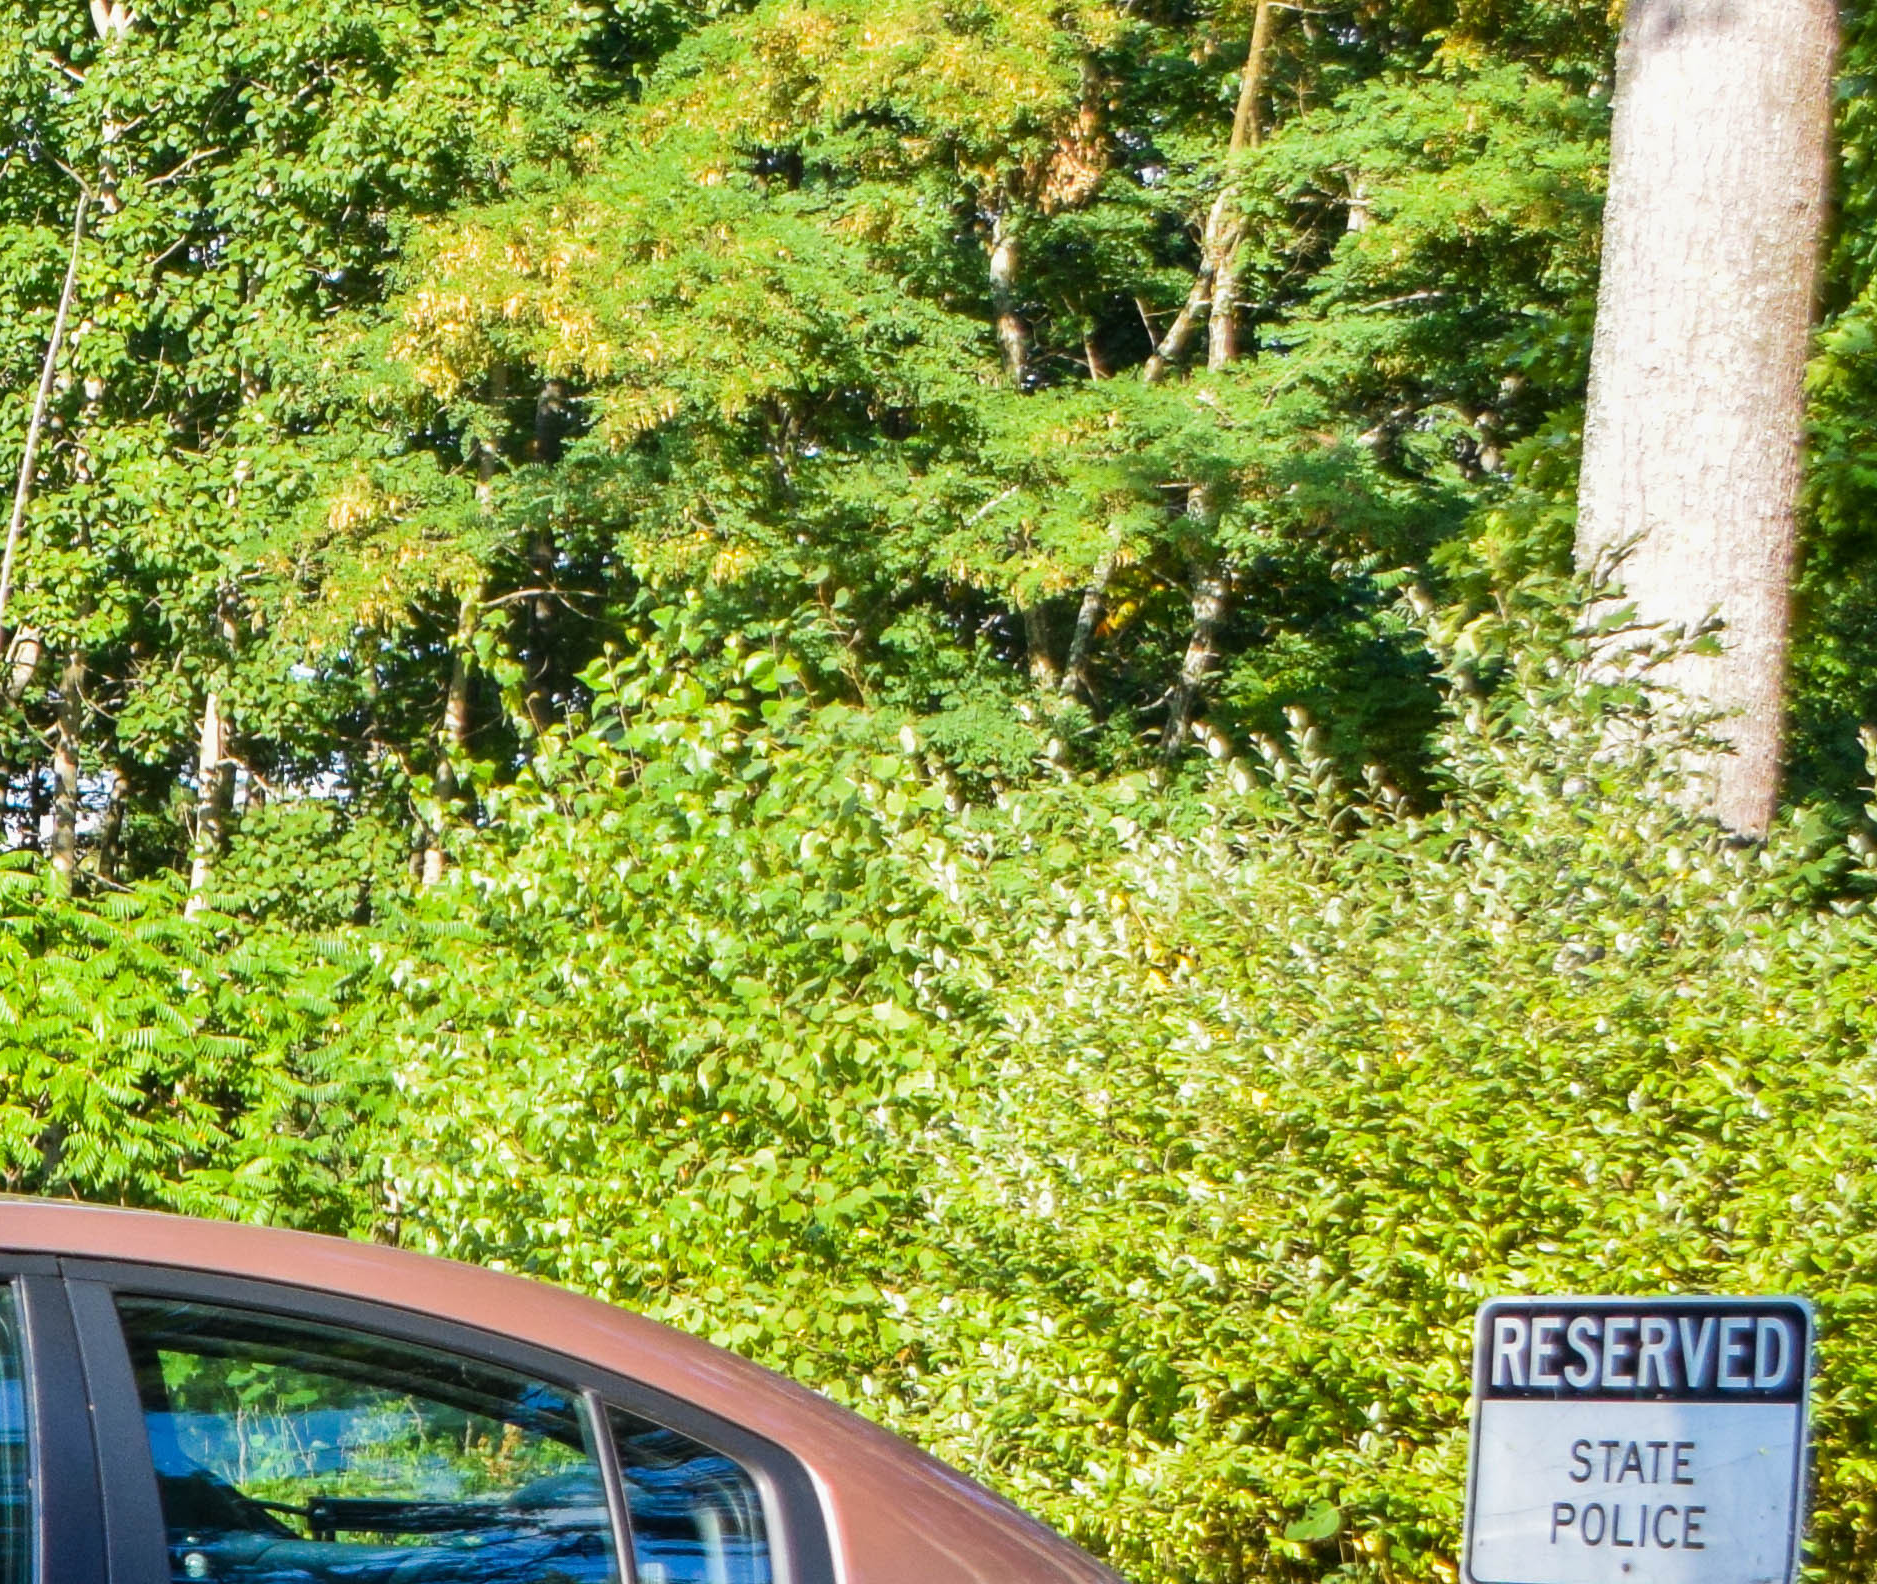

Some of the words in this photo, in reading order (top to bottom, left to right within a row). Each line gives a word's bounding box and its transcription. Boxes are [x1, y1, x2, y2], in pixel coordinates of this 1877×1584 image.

[1491, 1315, 1793, 1390] RESERVED
[1568, 1438, 1696, 1486] STATE
[1549, 1501, 1707, 1550] POLICE
